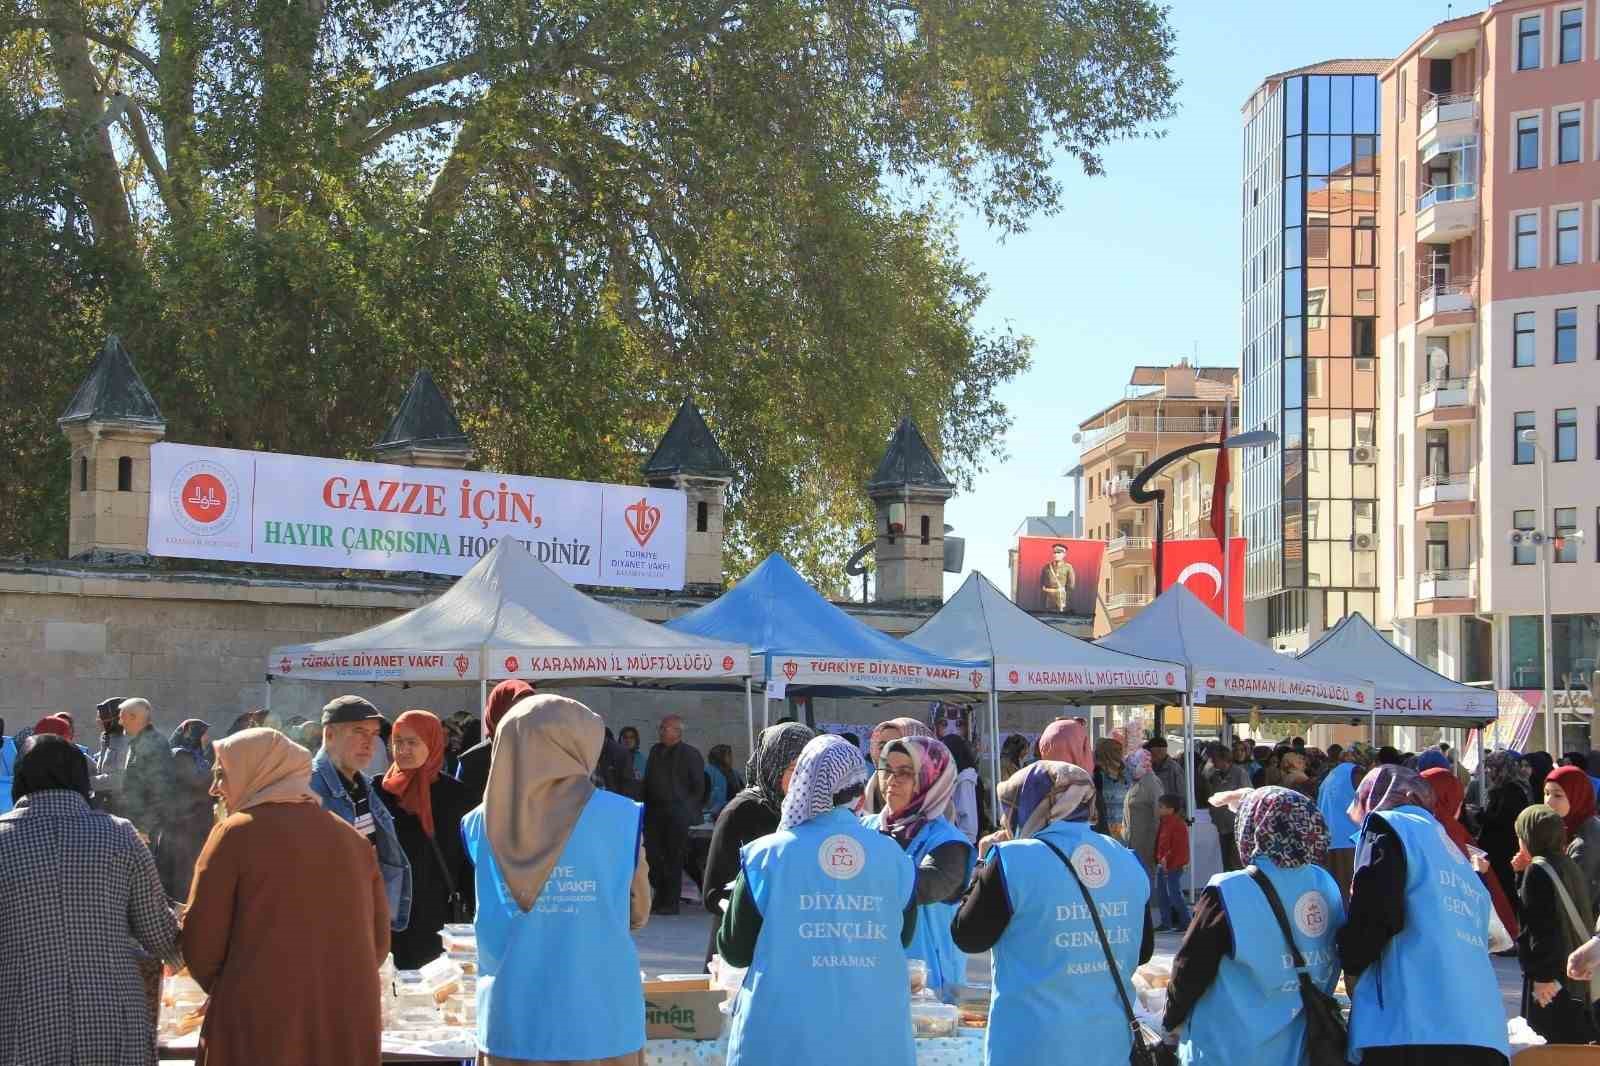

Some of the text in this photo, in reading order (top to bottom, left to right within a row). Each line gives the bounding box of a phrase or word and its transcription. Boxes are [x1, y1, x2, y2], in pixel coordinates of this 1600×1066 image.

[322, 476, 542, 529] GAZZE İÇİN,
[264, 520, 334, 548] HAYIR
[341, 526, 452, 558] ÇARŞISINA
[302, 652, 444, 667] TÜRKİYE DİYANET VAKFI
[531, 652, 713, 671] KARAMAN İL MÜFTÜLÜĞÜ
[811, 659, 865, 673] TÜRKİYE
[869, 661, 922, 677] DİYANET
[1028, 671, 1082, 685] KARAMAN
[1083, 668, 1095, 685] İL
[1224, 677, 1276, 692] KARAMAN
[799, 891, 883, 912] DİYANET
[1056, 901, 1129, 921] DİYNET
[798, 919, 888, 944] GENÇLİK
[811, 955, 878, 969] KARAMAN
[646, 1009, 695, 1024] INAR
